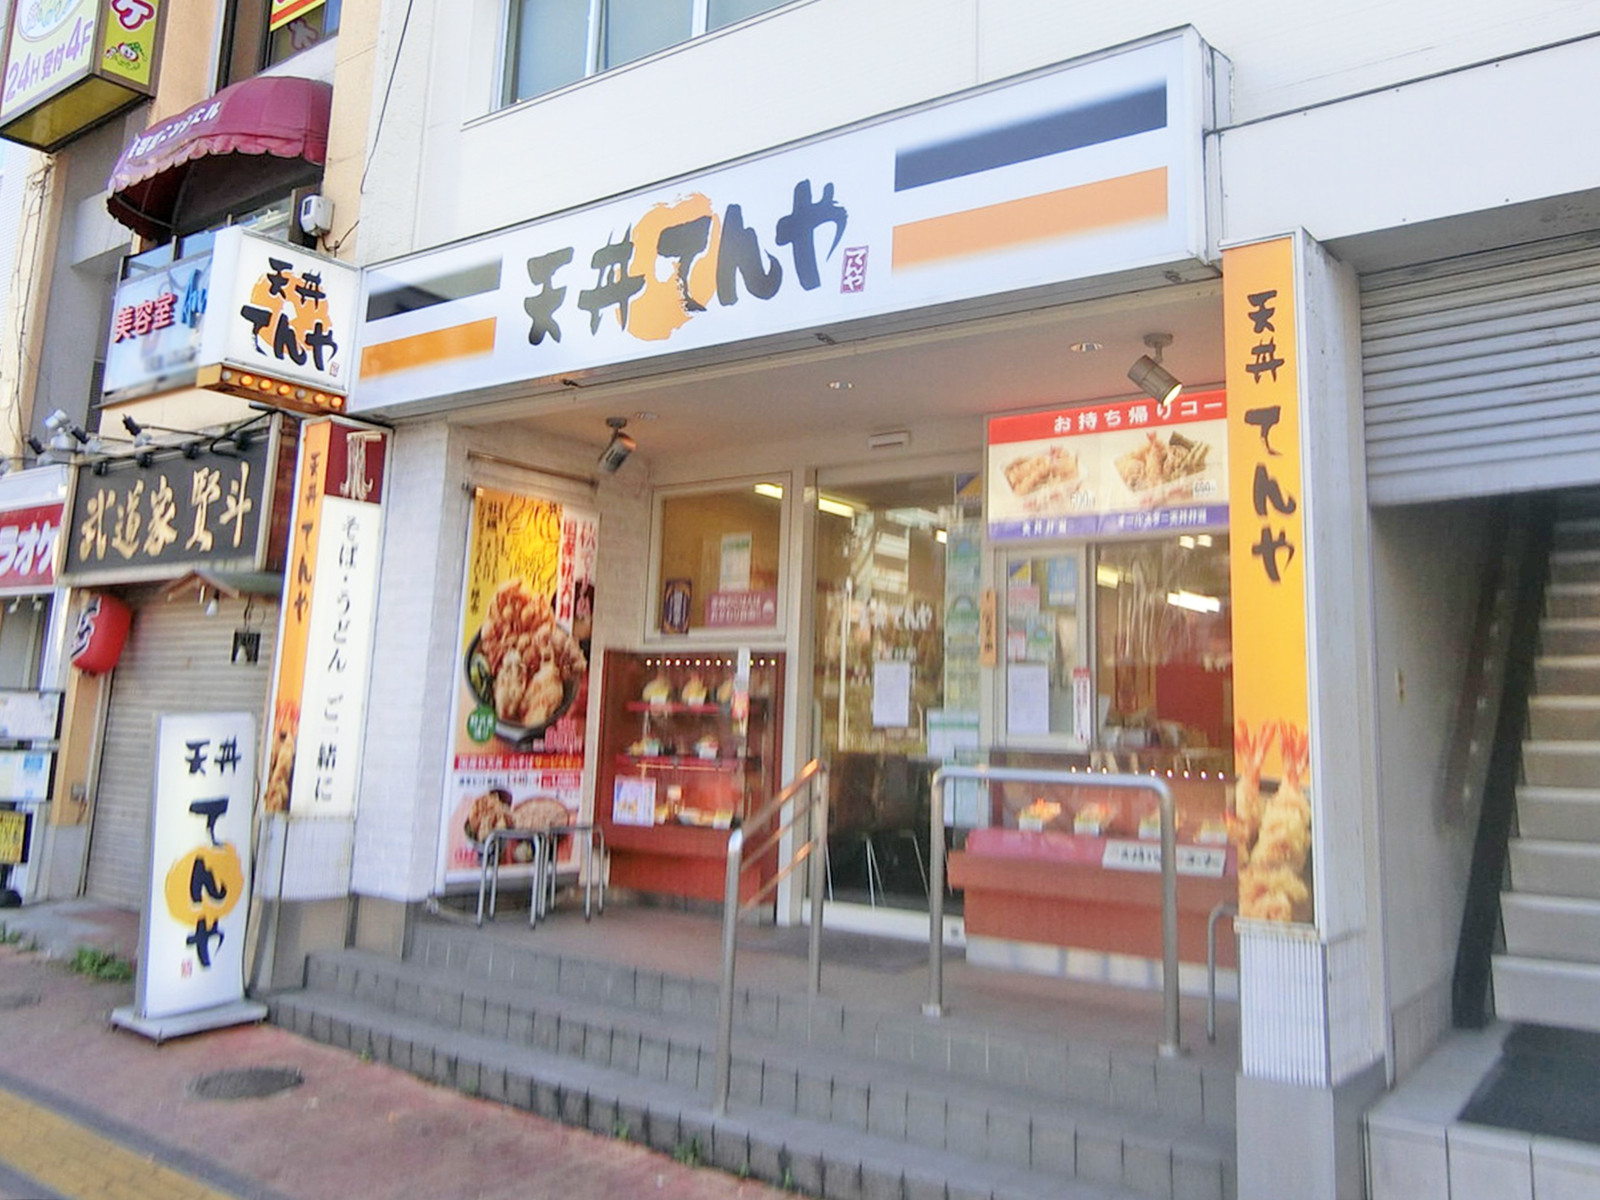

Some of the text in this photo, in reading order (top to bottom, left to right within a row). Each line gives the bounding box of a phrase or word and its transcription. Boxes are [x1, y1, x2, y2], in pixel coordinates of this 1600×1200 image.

[114, 292, 178, 343] 美容室
[240, 304, 338, 371] てんや
[266, 256, 328, 311] 天丼
[1243, 288, 1297, 583] 天丼 てんや
[293, 451, 321, 623] 天丼 てんや
[314, 515, 361, 803] そば・うどん ご一緒に
[184, 735, 241, 776] 天丼
[185, 796, 228, 968] てんや
